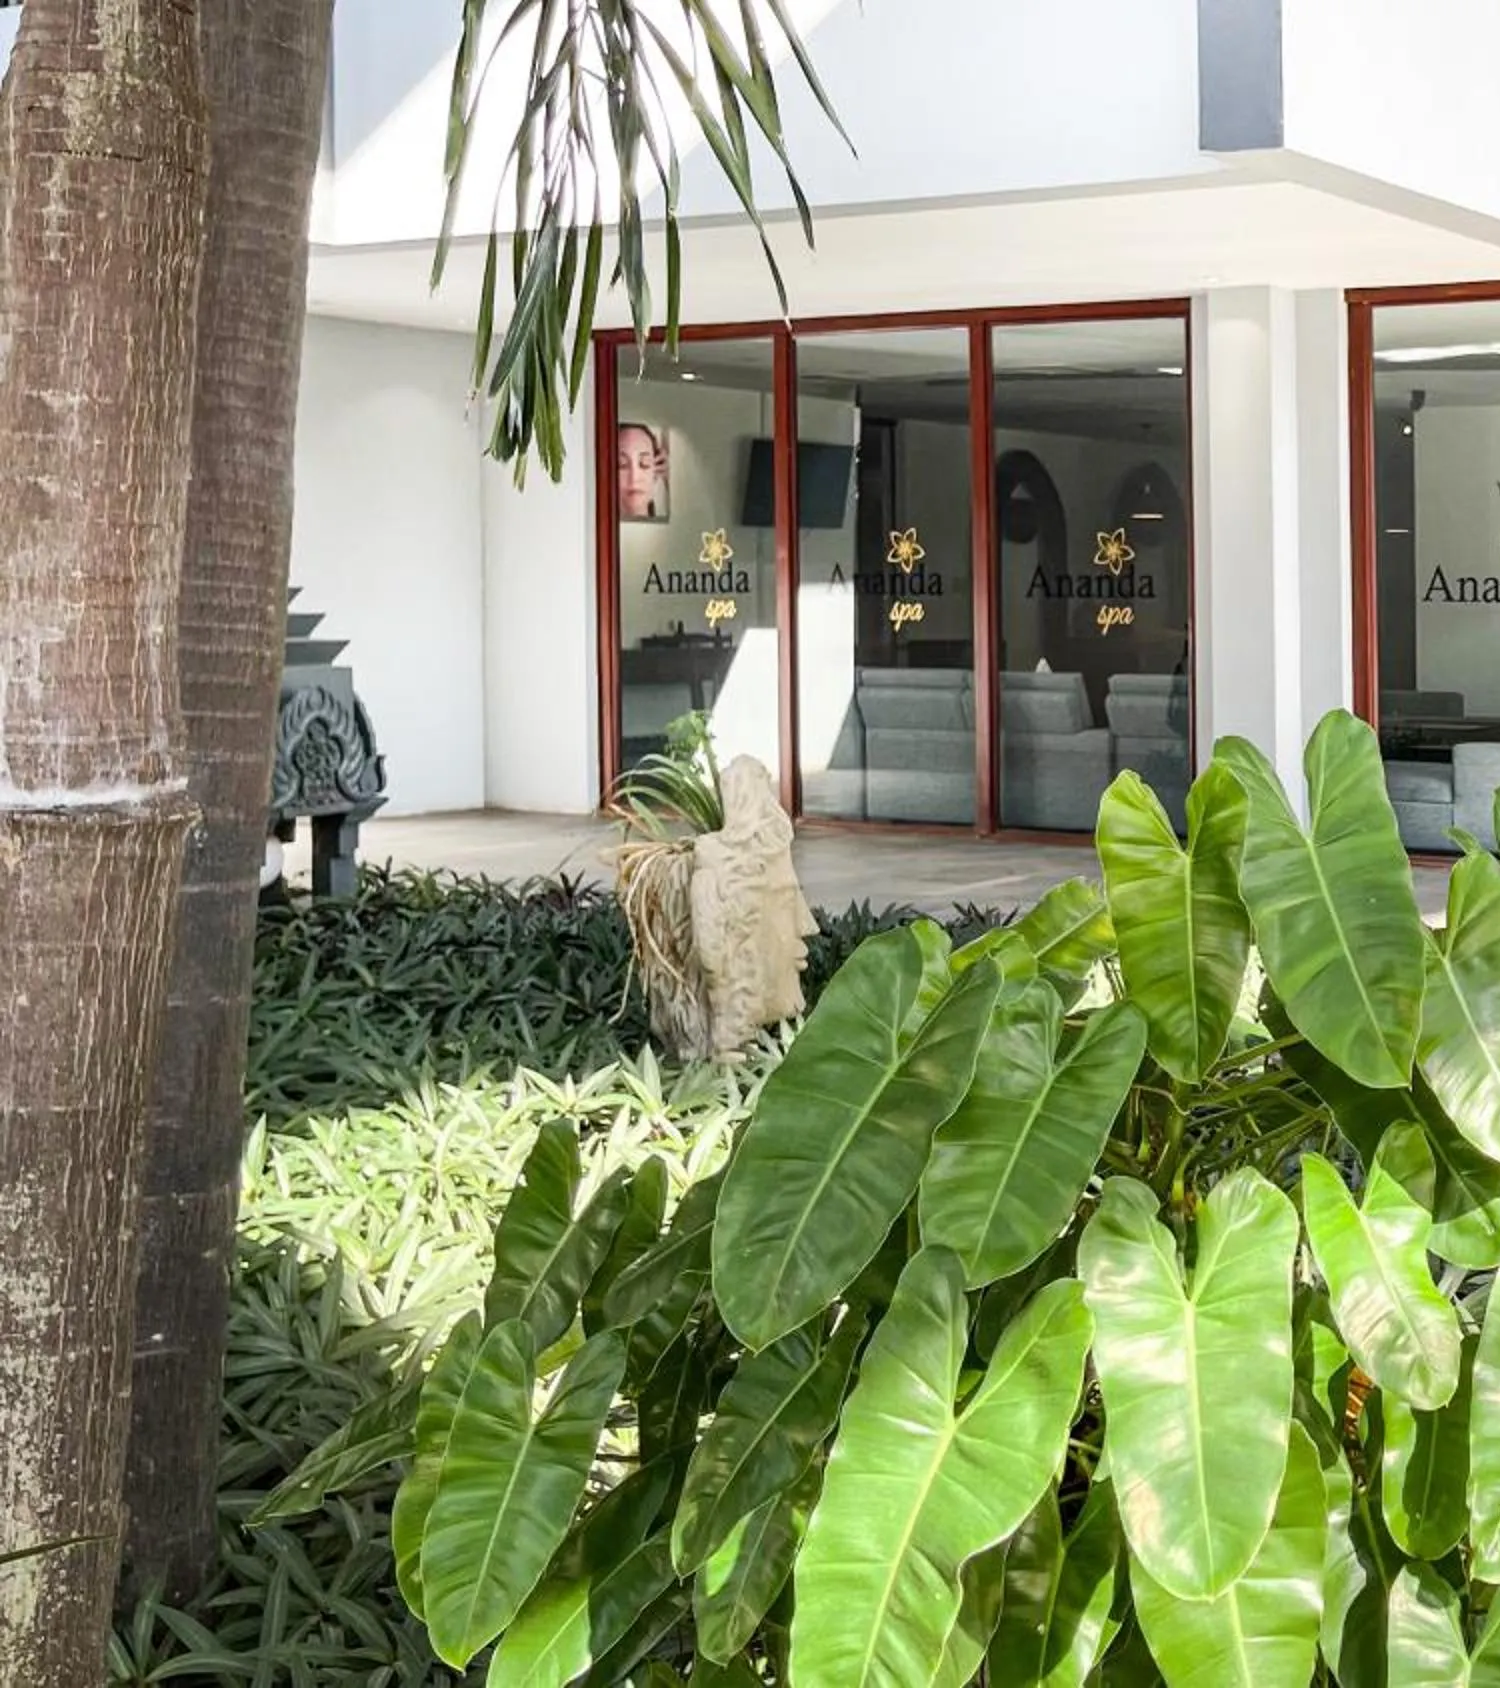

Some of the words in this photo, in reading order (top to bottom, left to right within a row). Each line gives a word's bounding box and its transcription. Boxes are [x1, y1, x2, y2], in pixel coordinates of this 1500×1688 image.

[642, 561, 750, 594] Ananda
[829, 561, 944, 596] Ananda
[1026, 563, 1156, 599] Ananda
[705, 599, 737, 628] spa
[889, 600, 925, 632] spa
[1097, 604, 1135, 636] spa
